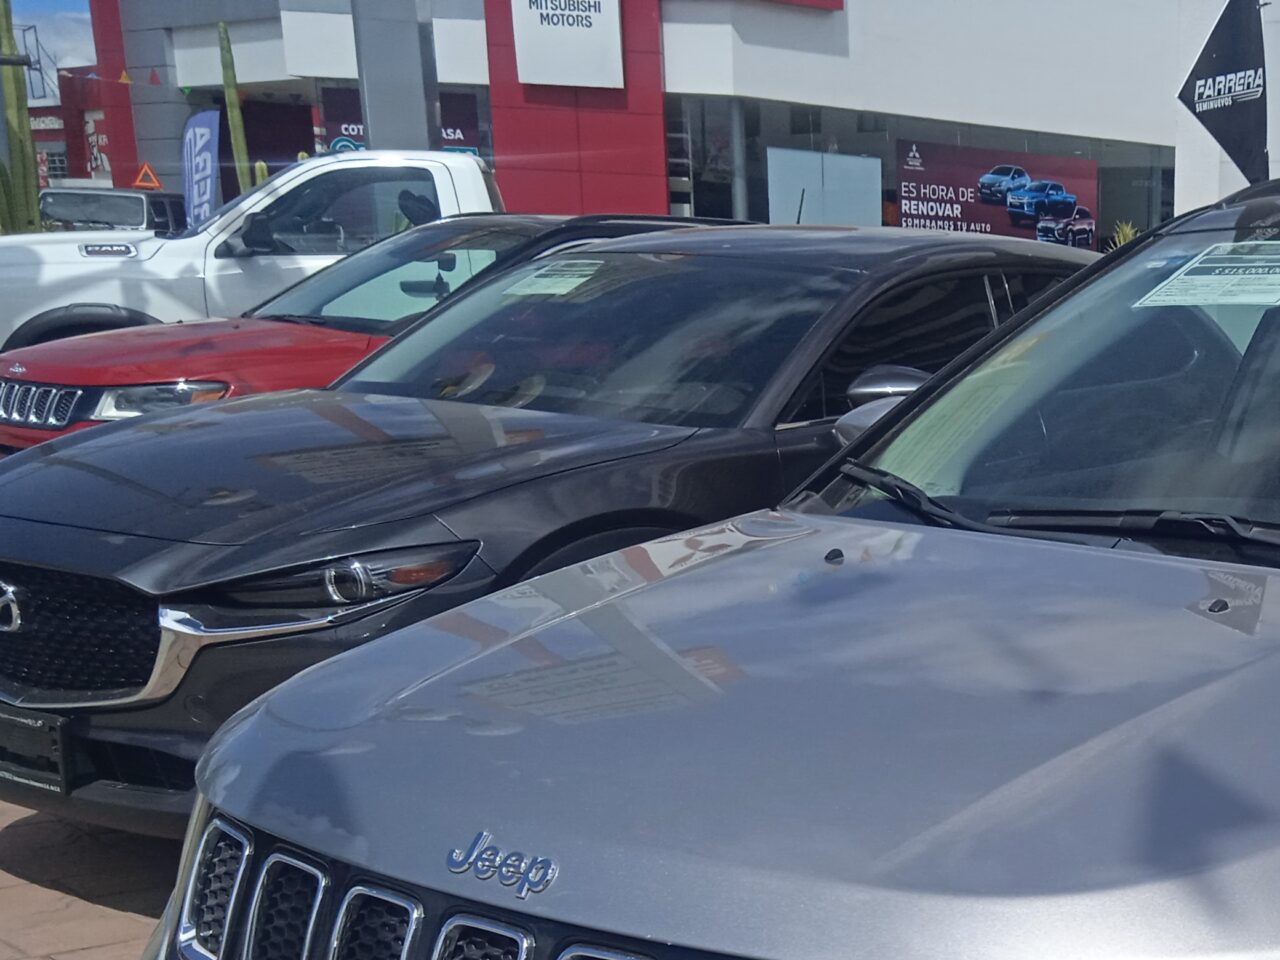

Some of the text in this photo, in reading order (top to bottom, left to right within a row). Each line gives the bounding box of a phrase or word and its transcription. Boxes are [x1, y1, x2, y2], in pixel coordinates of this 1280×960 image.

[528, 0, 601, 13] MITSUBISHI
[540, 12, 593, 28] MOTORS
[1194, 67, 1264, 101] FARRERA
[1195, 96, 1233, 113] SEMINUEVOS
[901, 181, 975, 203] ES HORA DE
[901, 199, 962, 218] RENOVAR
[902, 217, 991, 233] COMPRAMOS TU AUTO
[447, 829, 559, 900] Jeep
